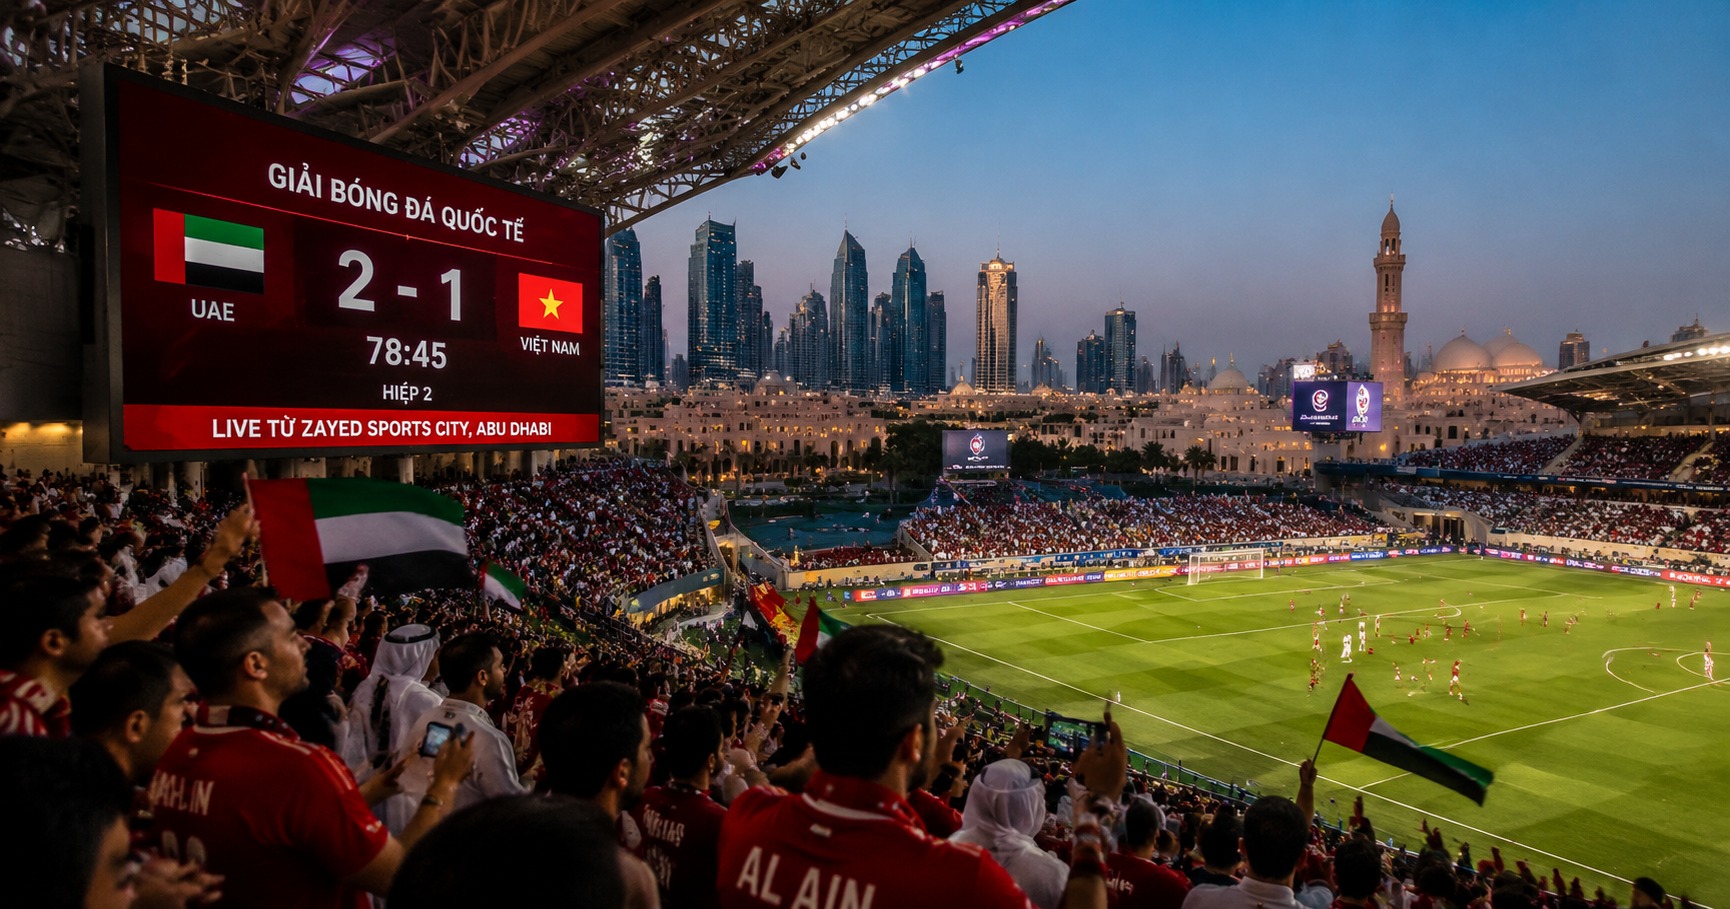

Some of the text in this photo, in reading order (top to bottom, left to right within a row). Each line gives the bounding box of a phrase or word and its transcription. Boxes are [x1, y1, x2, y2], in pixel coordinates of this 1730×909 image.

[268, 162, 322, 199] GIẢI
[330, 177, 399, 215] BÓNG
[405, 196, 436, 224] ĐÁ
[441, 207, 498, 237] QUỐC
[338, 249, 375, 312] 2
[440, 268, 461, 322] 1
[191, 298, 235, 323] UAE
[366, 336, 448, 370] 78:45
[520, 335, 581, 356] VIỆT NAM
[422, 386, 433, 401] 2
[212, 414, 552, 439] LIVE TỪ ZAYED SPORTS CITY, ABU DHABI
[735, 844, 783, 907] AL
[788, 865, 878, 909] AIN
